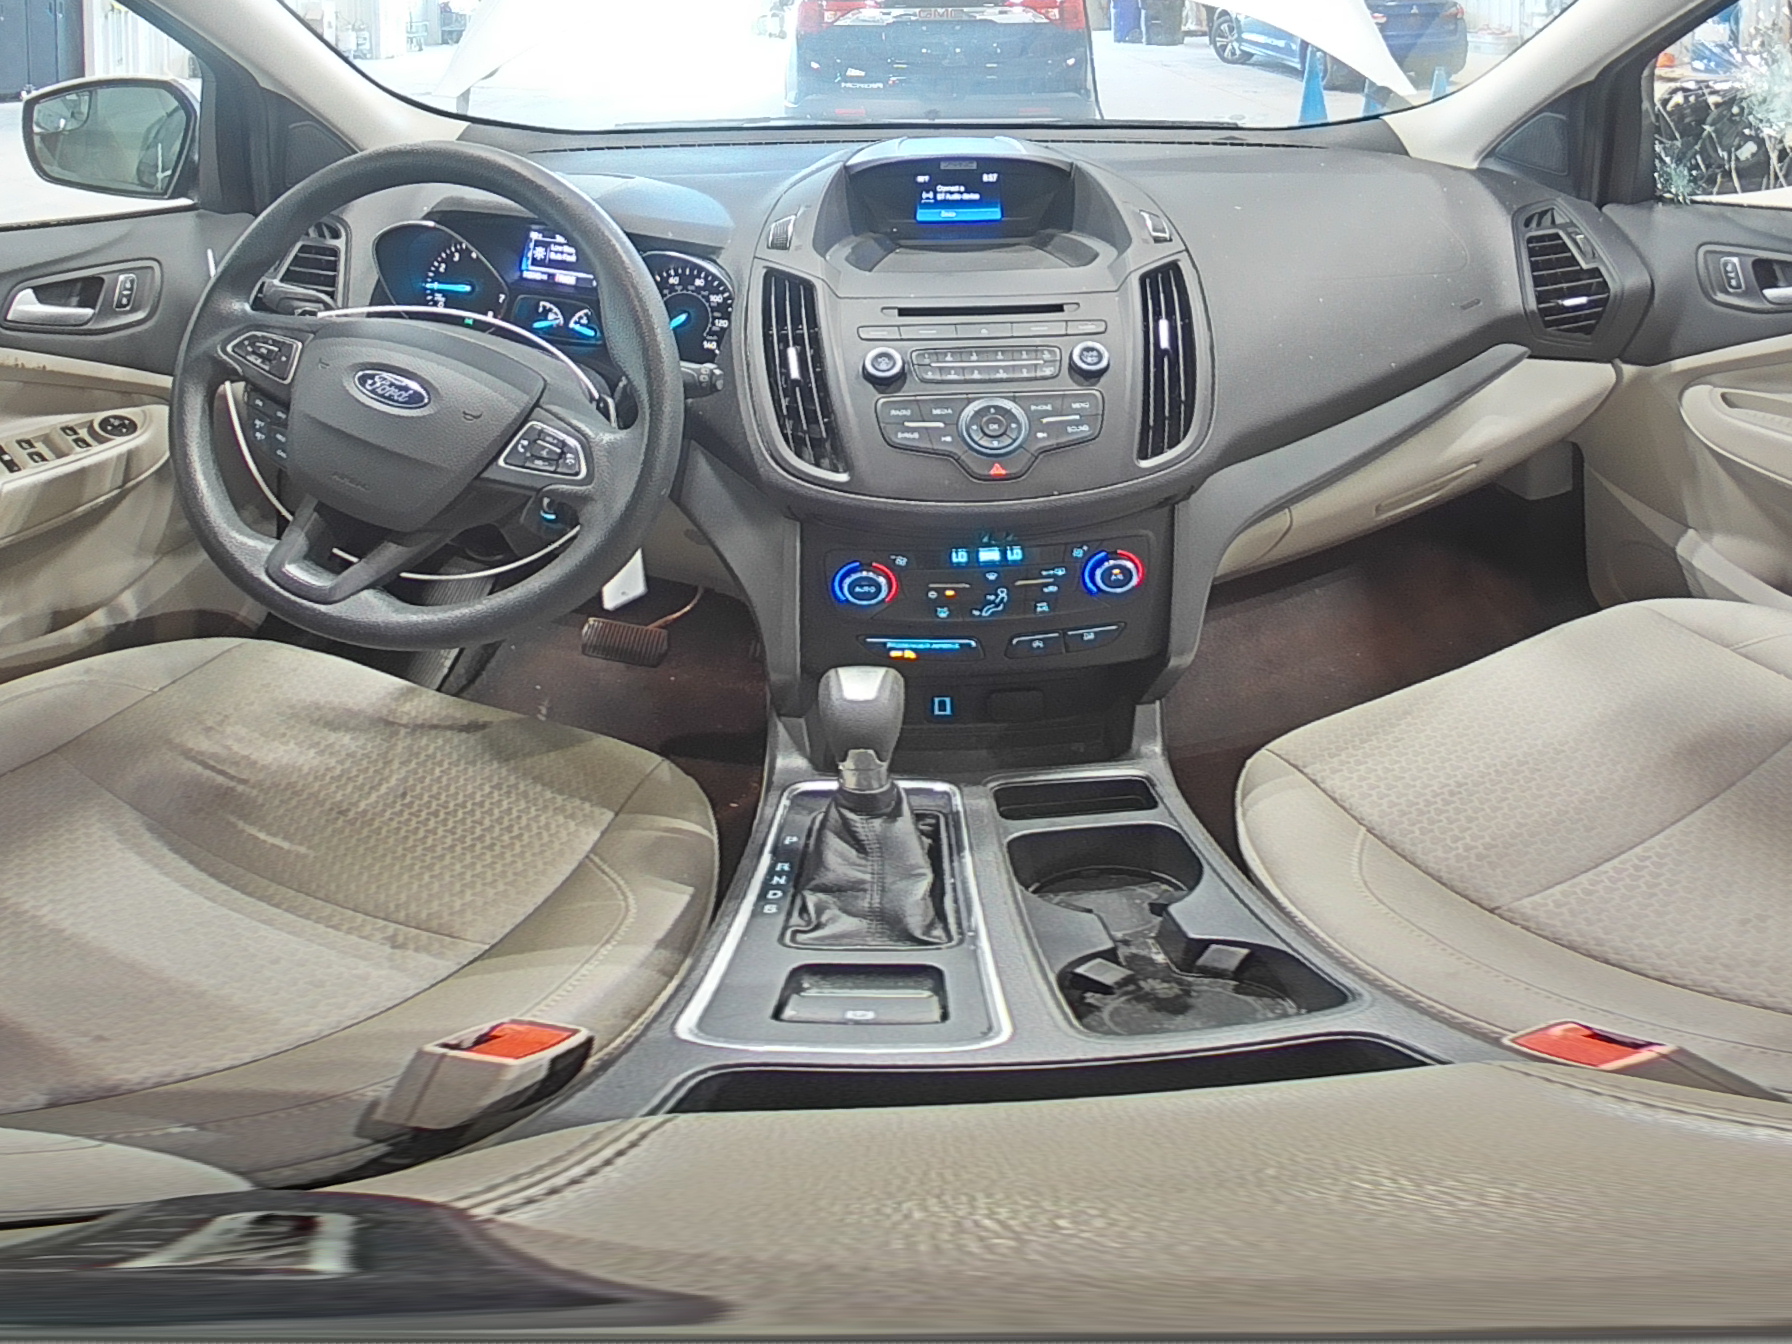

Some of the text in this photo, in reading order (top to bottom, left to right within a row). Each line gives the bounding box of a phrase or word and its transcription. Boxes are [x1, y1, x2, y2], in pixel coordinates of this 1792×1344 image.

[918, 8, 963, 19] GMC
[668, 276, 679, 284] 60
[694, 278, 705, 286] 80
[498, 293, 506, 303] 7
[709, 294, 723, 303] 100
[715, 319, 729, 327] 120
[364, 374, 414, 402] Ford
[763, 835, 798, 914] P R N D S
